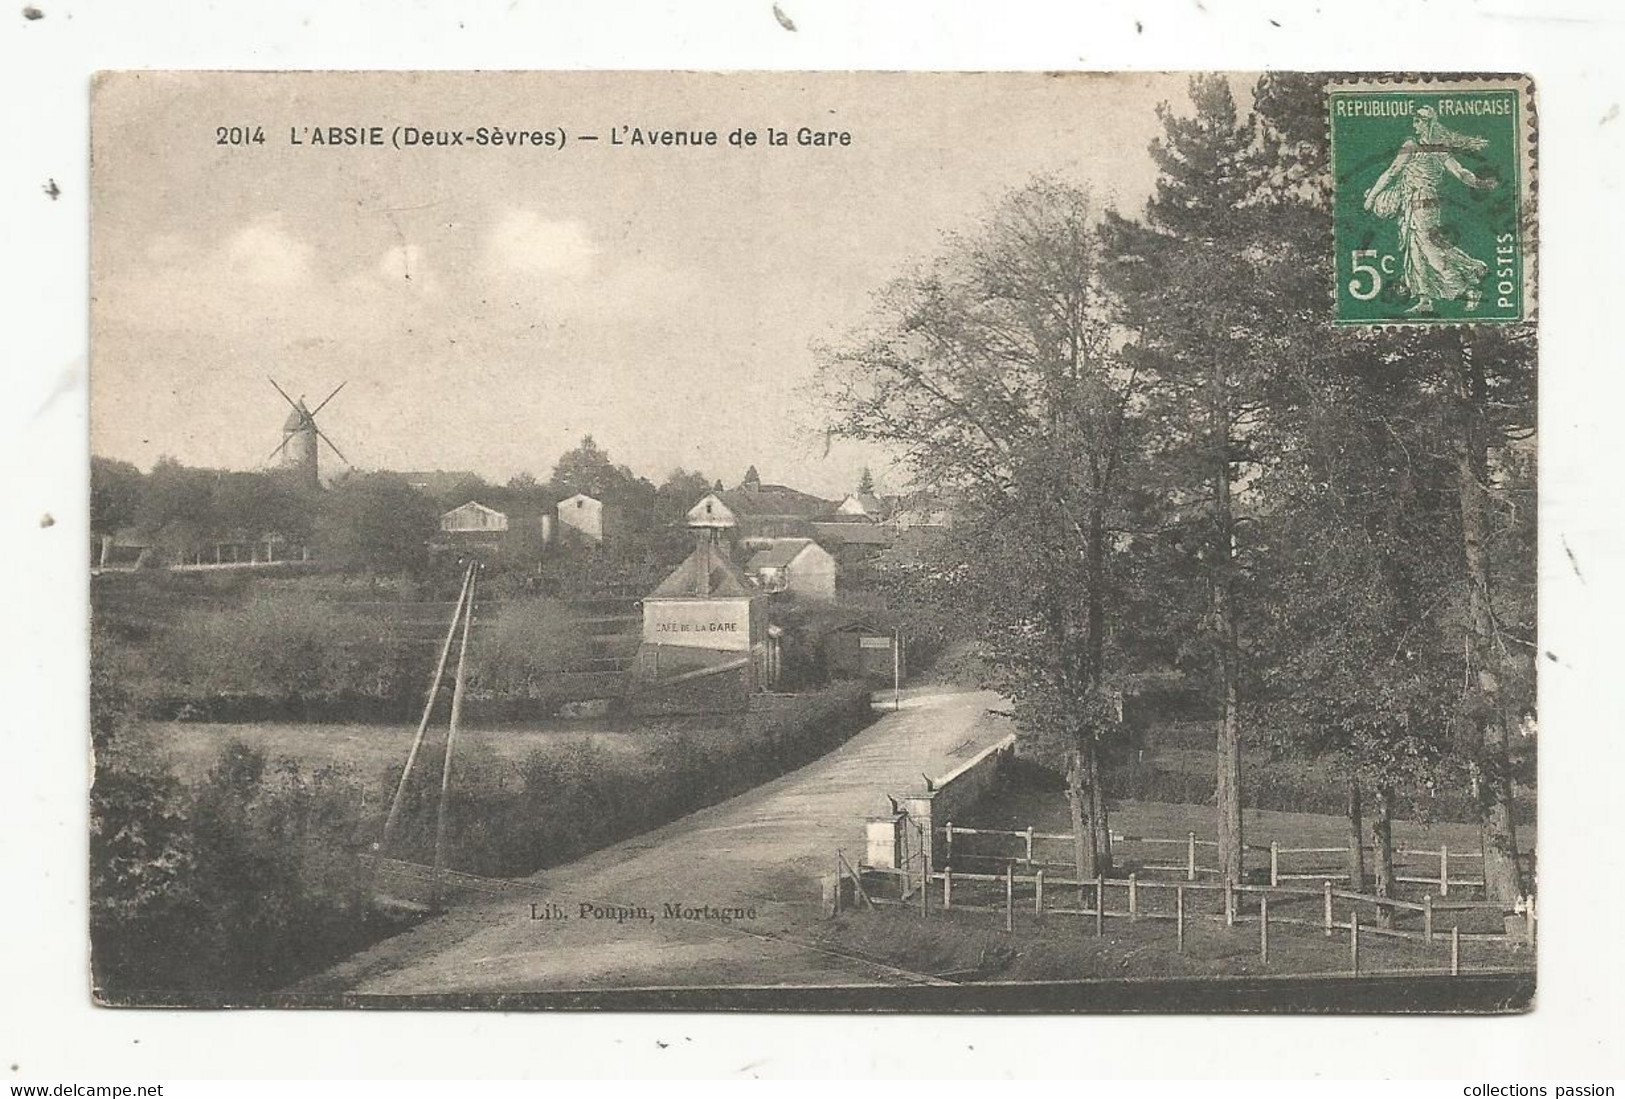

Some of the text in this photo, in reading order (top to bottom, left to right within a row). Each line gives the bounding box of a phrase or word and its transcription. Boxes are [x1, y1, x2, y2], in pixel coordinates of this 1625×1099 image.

[1497, 233, 1514, 308] POSTES
[681, 624, 690, 632] DE
[695, 624, 706, 632] LA
[709, 622, 737, 632] GARE
